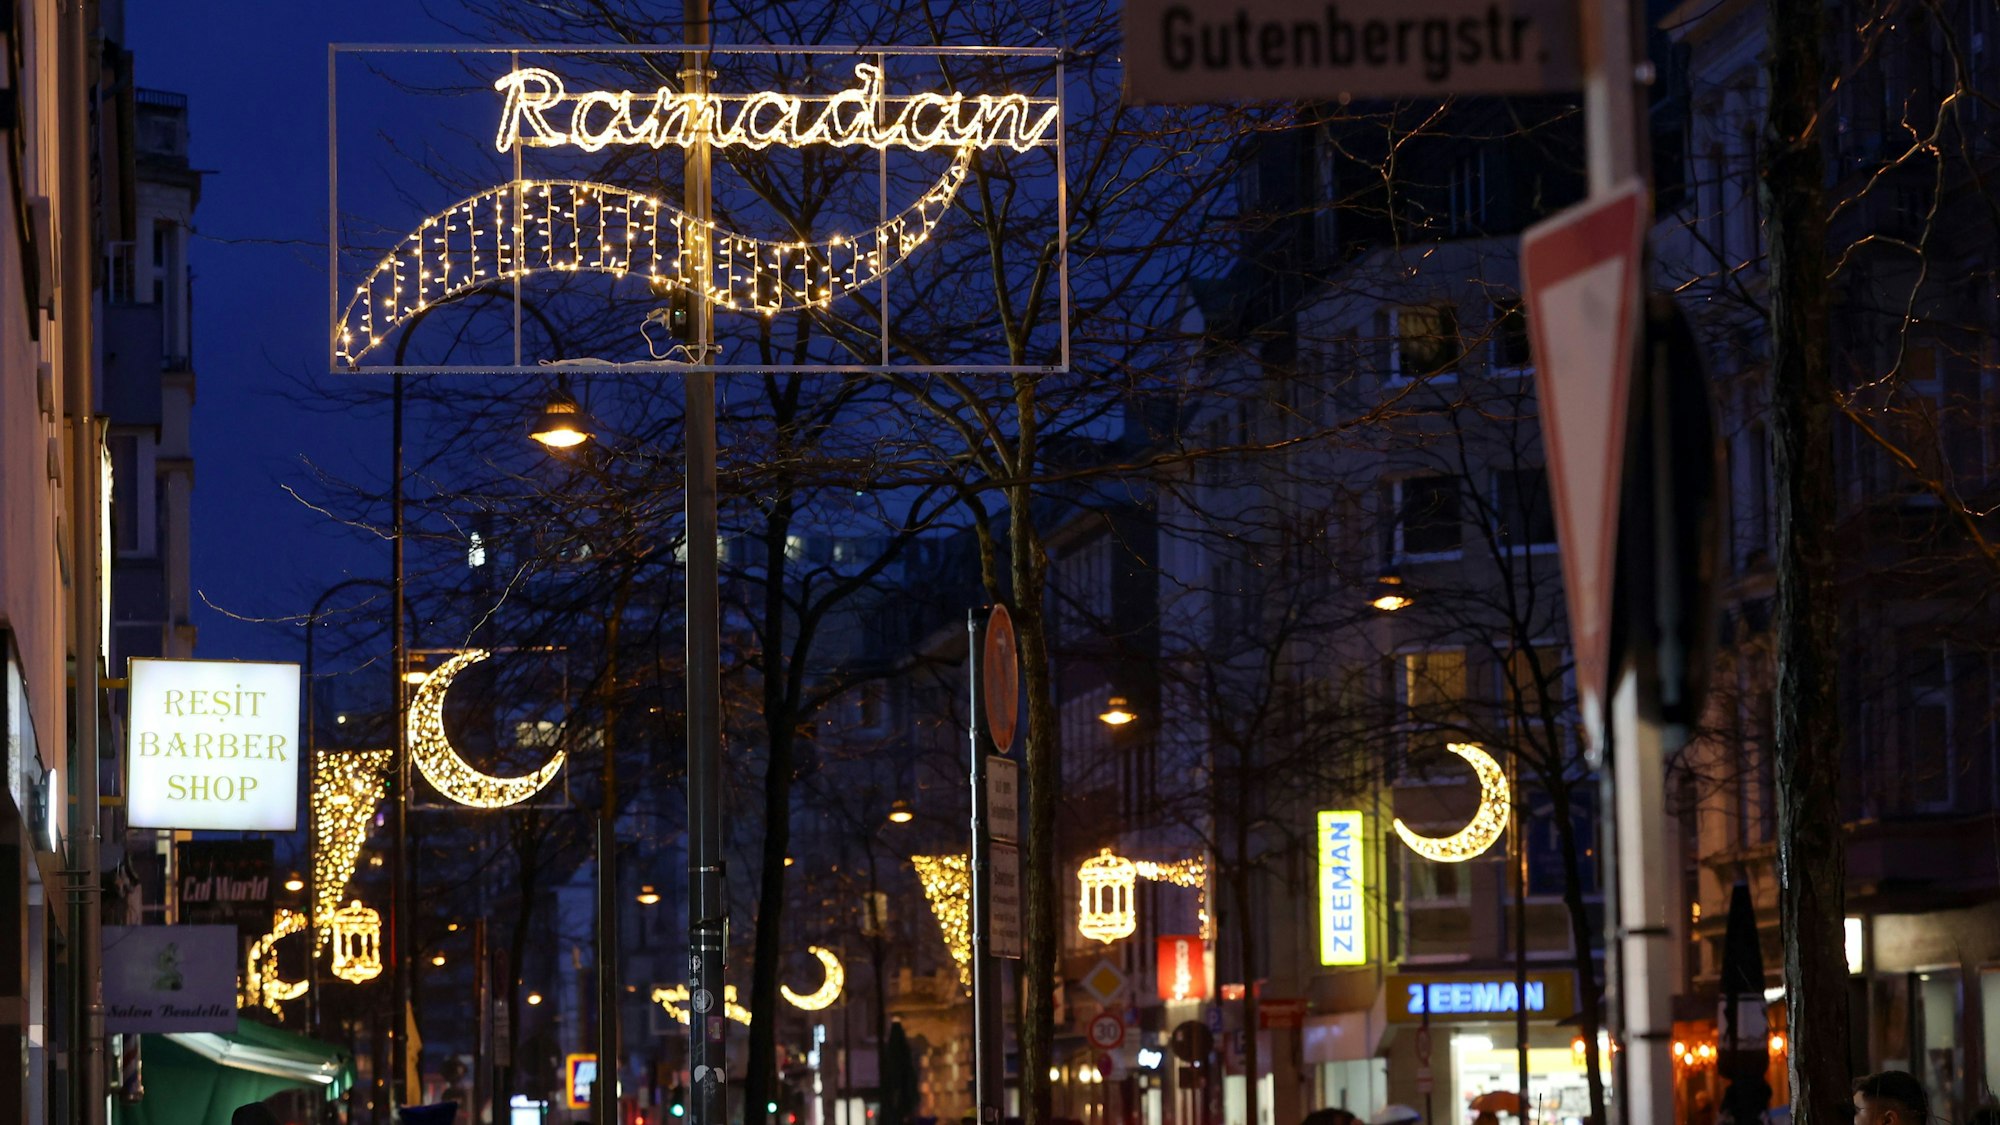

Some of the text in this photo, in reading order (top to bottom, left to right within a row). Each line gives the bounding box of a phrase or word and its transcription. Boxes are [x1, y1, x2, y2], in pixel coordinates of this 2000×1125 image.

[1161, 4, 1550, 82] Gutenbergstr.
[494, 62, 1058, 153] Ramadan
[138, 731, 288, 762] BARBER
[166, 774, 259, 802] SHOP
[216, 876, 269, 901] World
[1330, 822, 1353, 952] ZEEMAN
[106, 1004, 153, 1018] Salon
[1407, 981, 1545, 1014] ZEEMAN
[1096, 1023, 1118, 1040] 30
